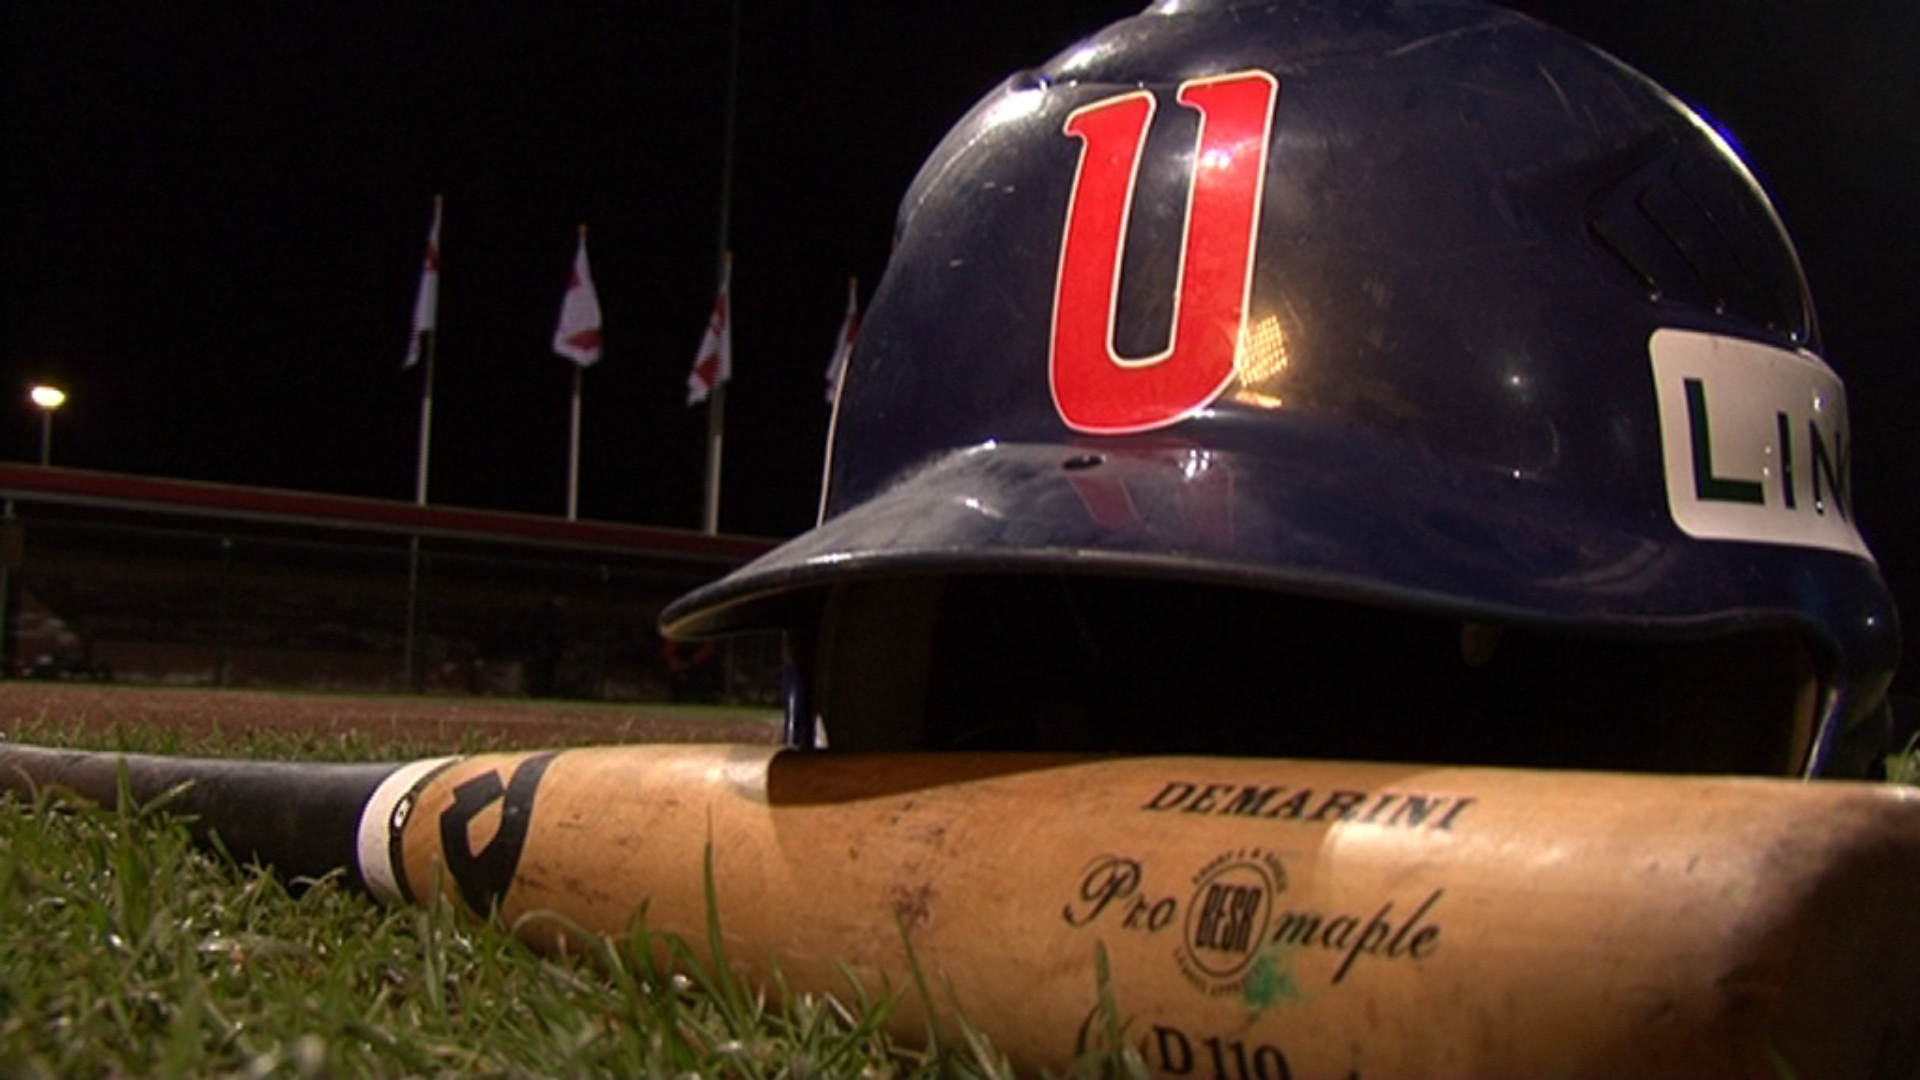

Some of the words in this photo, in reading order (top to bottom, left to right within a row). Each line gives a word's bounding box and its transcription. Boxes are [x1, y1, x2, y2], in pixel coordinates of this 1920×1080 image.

[1050, 69, 1279, 434] U
[1140, 780, 1478, 831] DEMARINI
[1063, 854, 1177, 929] Pro
[1272, 888, 1445, 984] maple
